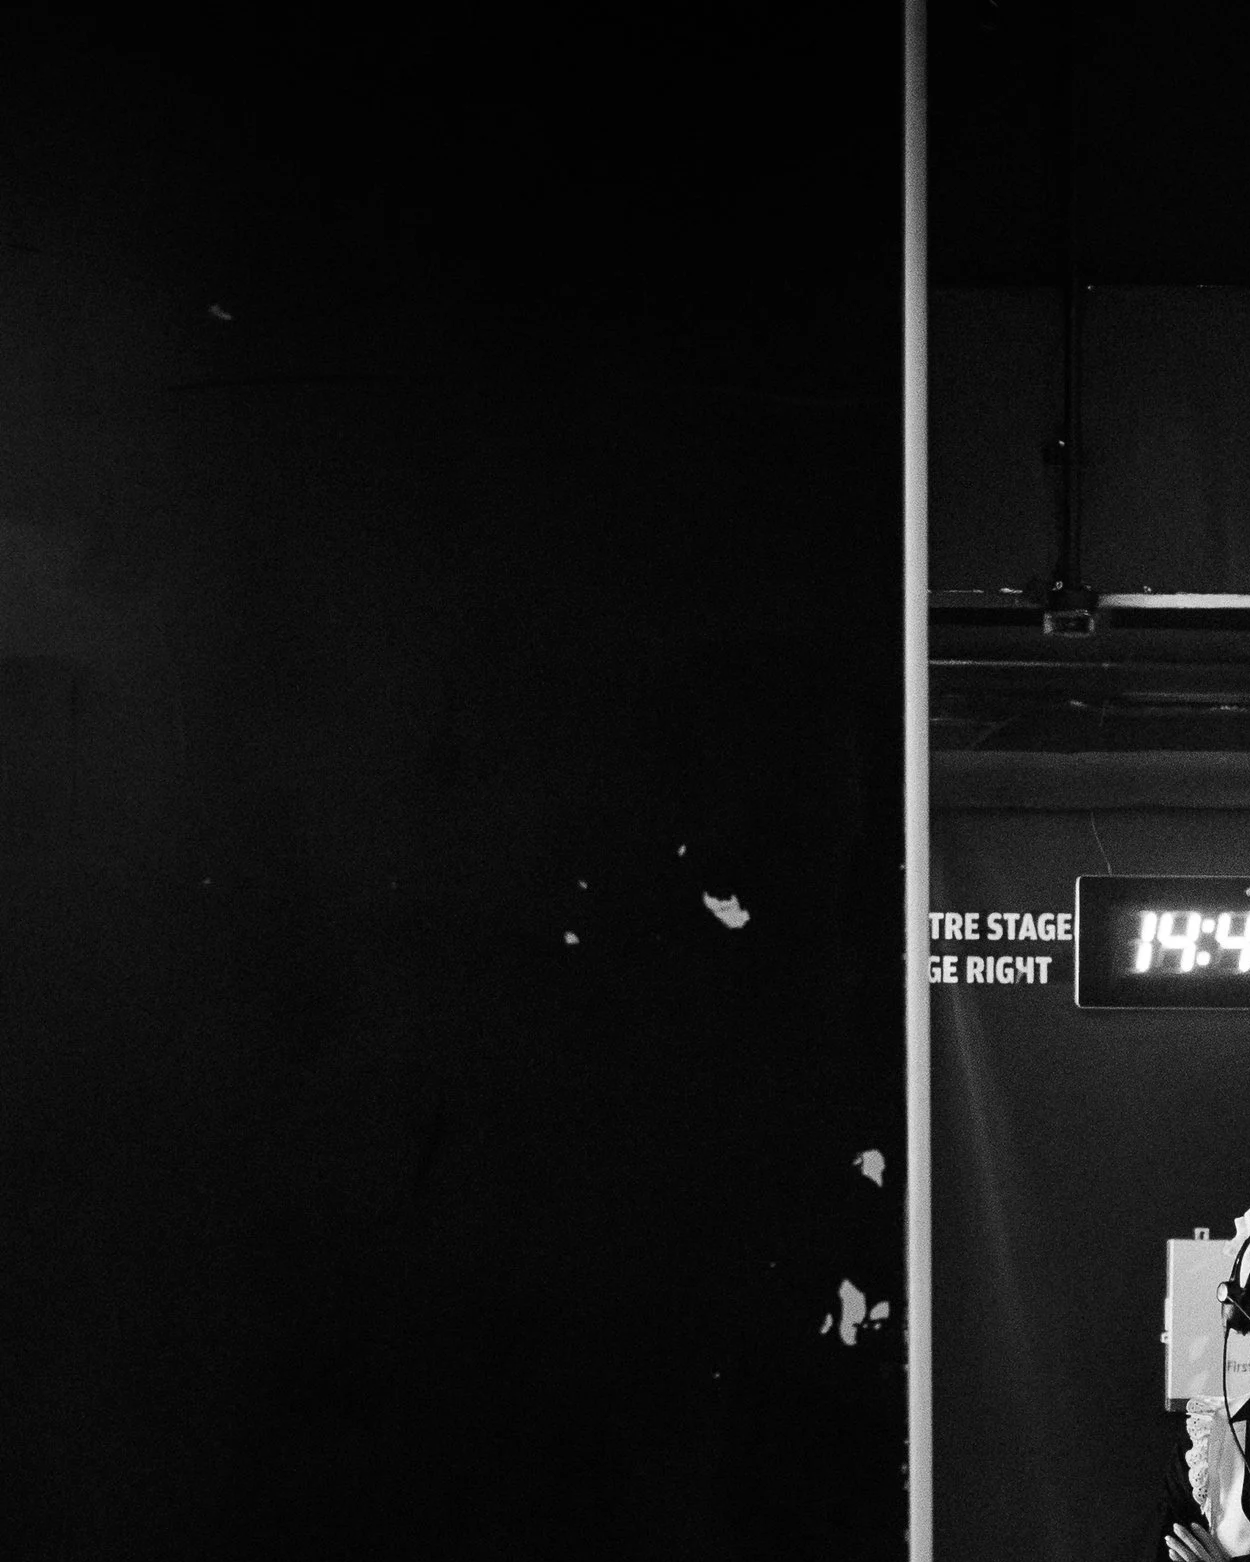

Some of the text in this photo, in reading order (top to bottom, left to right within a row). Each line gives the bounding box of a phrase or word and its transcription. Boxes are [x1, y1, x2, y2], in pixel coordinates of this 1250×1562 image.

[929, 912, 1073, 941] TRE STAGE
[929, 956, 958, 984] GE
